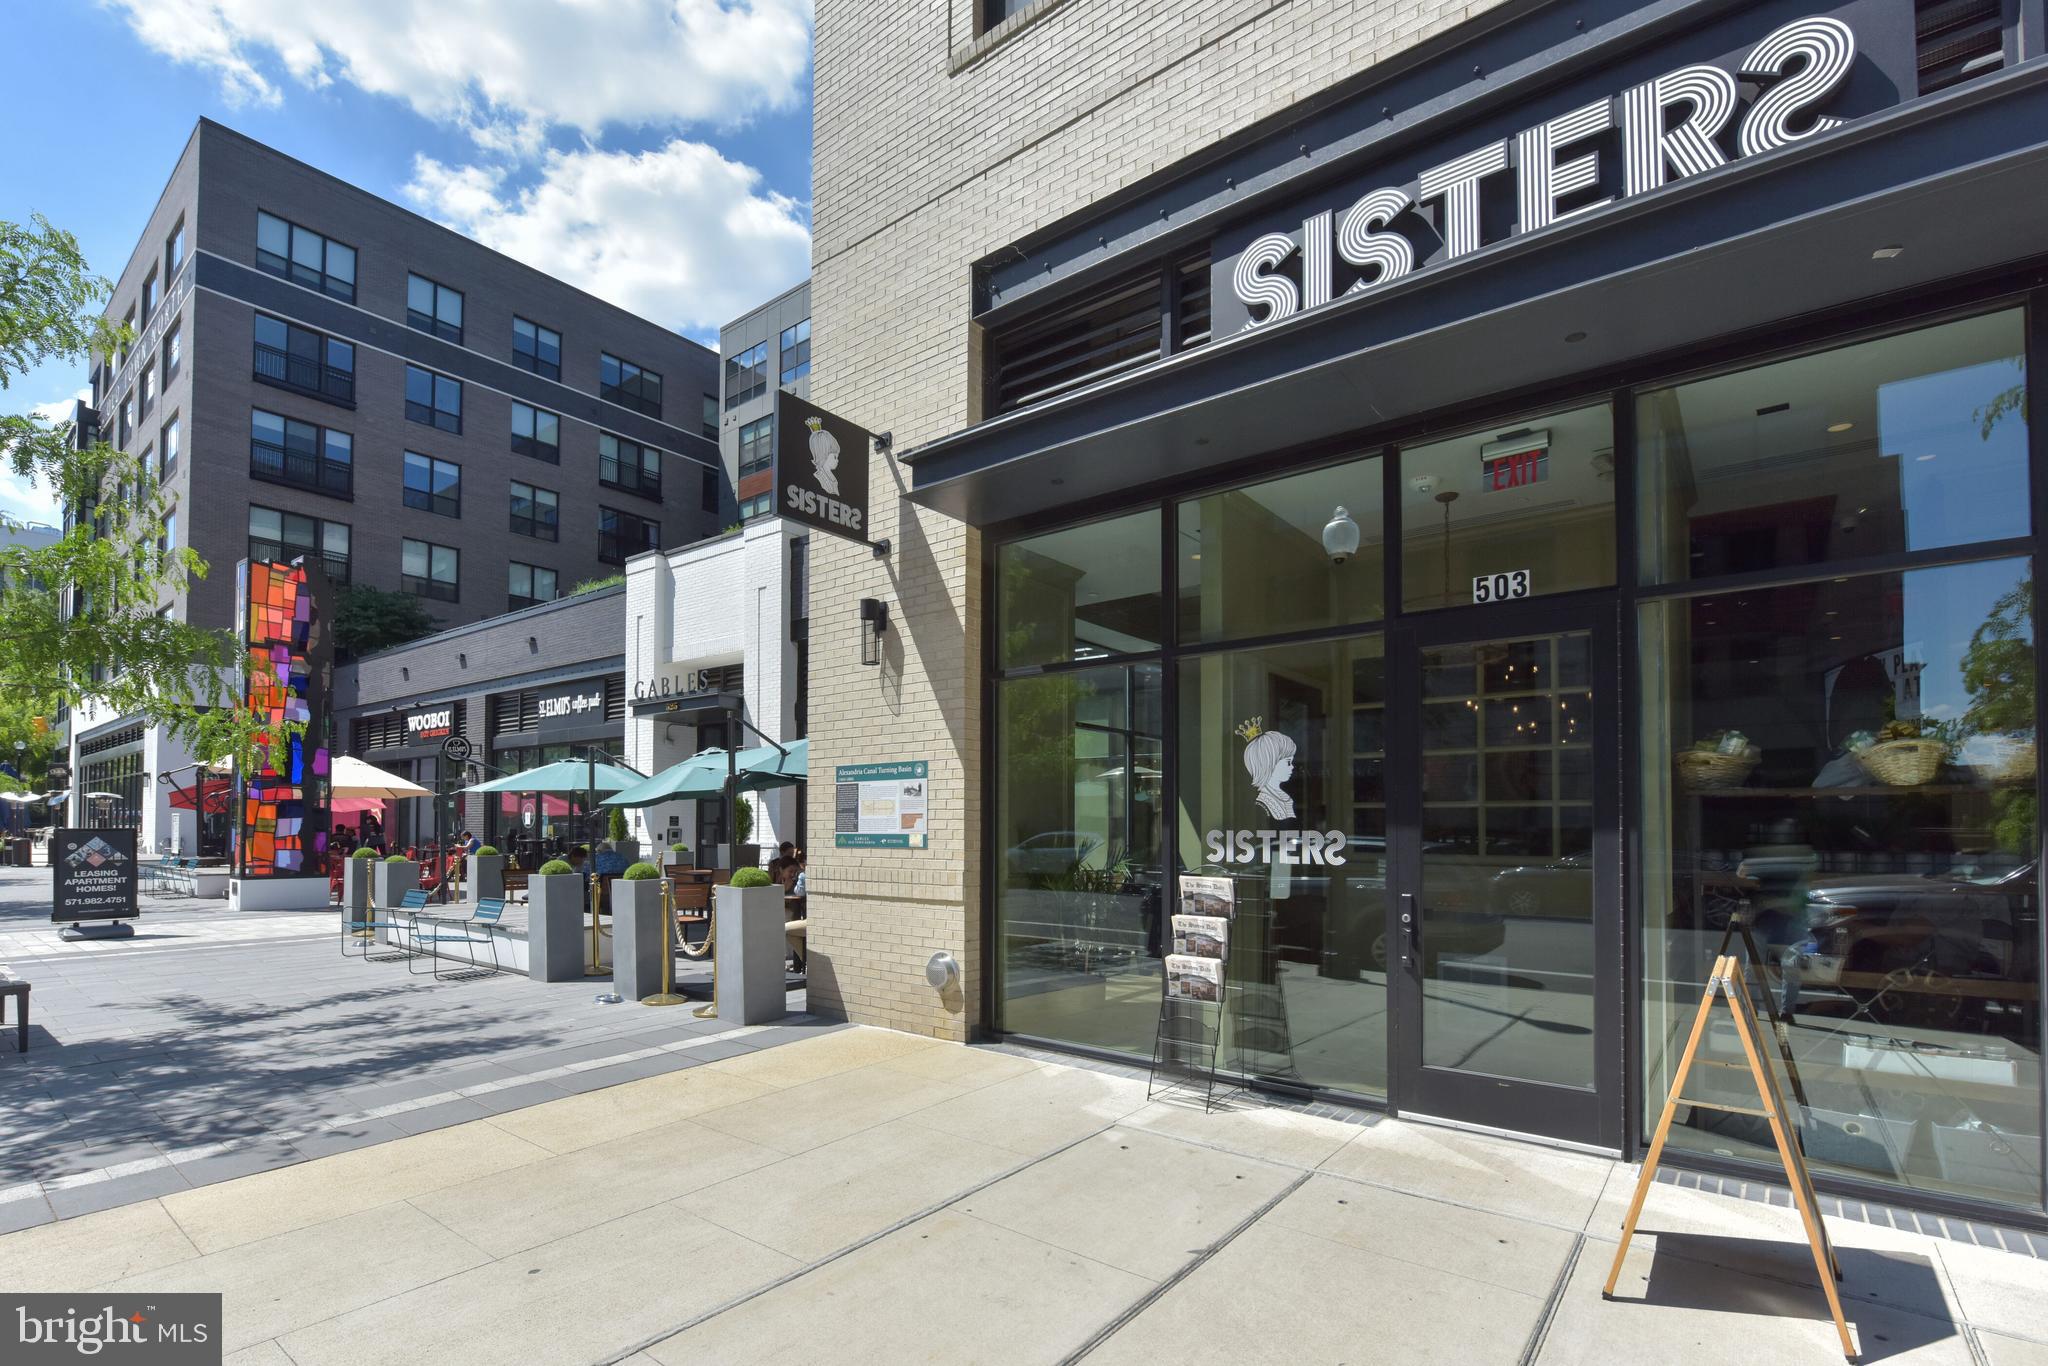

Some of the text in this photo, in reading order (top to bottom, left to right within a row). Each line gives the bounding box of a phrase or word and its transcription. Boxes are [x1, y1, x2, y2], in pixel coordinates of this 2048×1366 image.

[1233, 17, 1855, 332] SISTERS
[1493, 449, 1541, 490] EXIT
[787, 484, 862, 530] SISTERS
[1476, 571, 1527, 602] 503
[634, 670, 708, 702] GABLES
[407, 710, 450, 732] WOOBOI
[898, 765, 912, 773] Basin
[1206, 829, 1346, 866] SISTERS
[64, 876, 127, 886] APARTMENT
[76, 885, 117, 893] HOMES!
[65, 897, 126, 905] 571.982.4751
